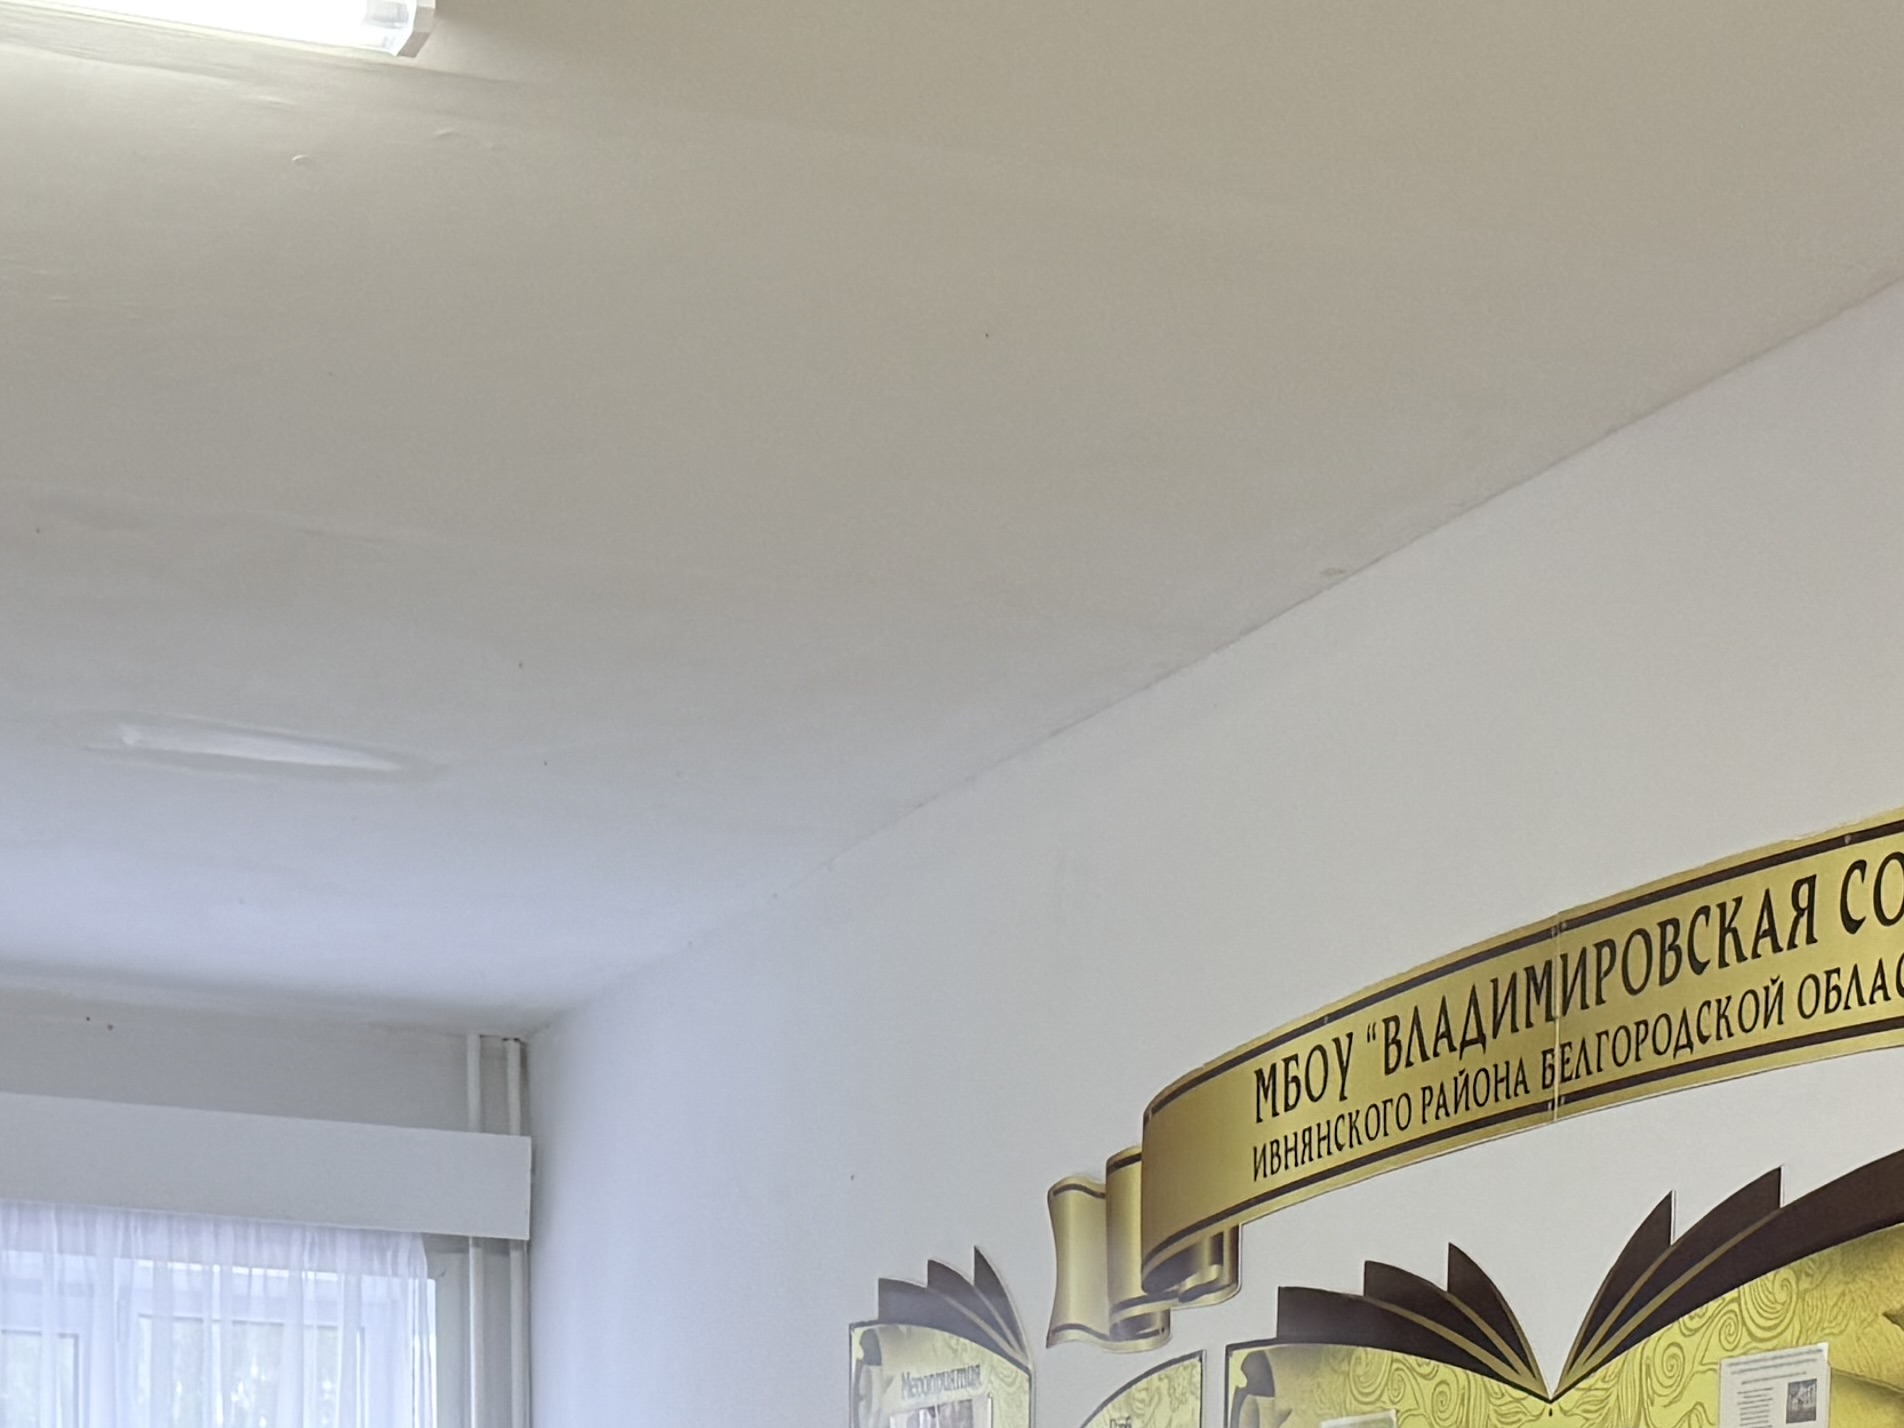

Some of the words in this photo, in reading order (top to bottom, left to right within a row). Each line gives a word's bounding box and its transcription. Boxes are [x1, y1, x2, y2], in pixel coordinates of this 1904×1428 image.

[1253, 1093, 1412, 1182] ИВНЯНСКОГО
[1421, 1057, 1530, 1125] РАЙОНА
[1541, 975, 1784, 1091] БЕЛГОРОДСКОЙ
[1254, 1032, 1353, 1123] МБОУ
